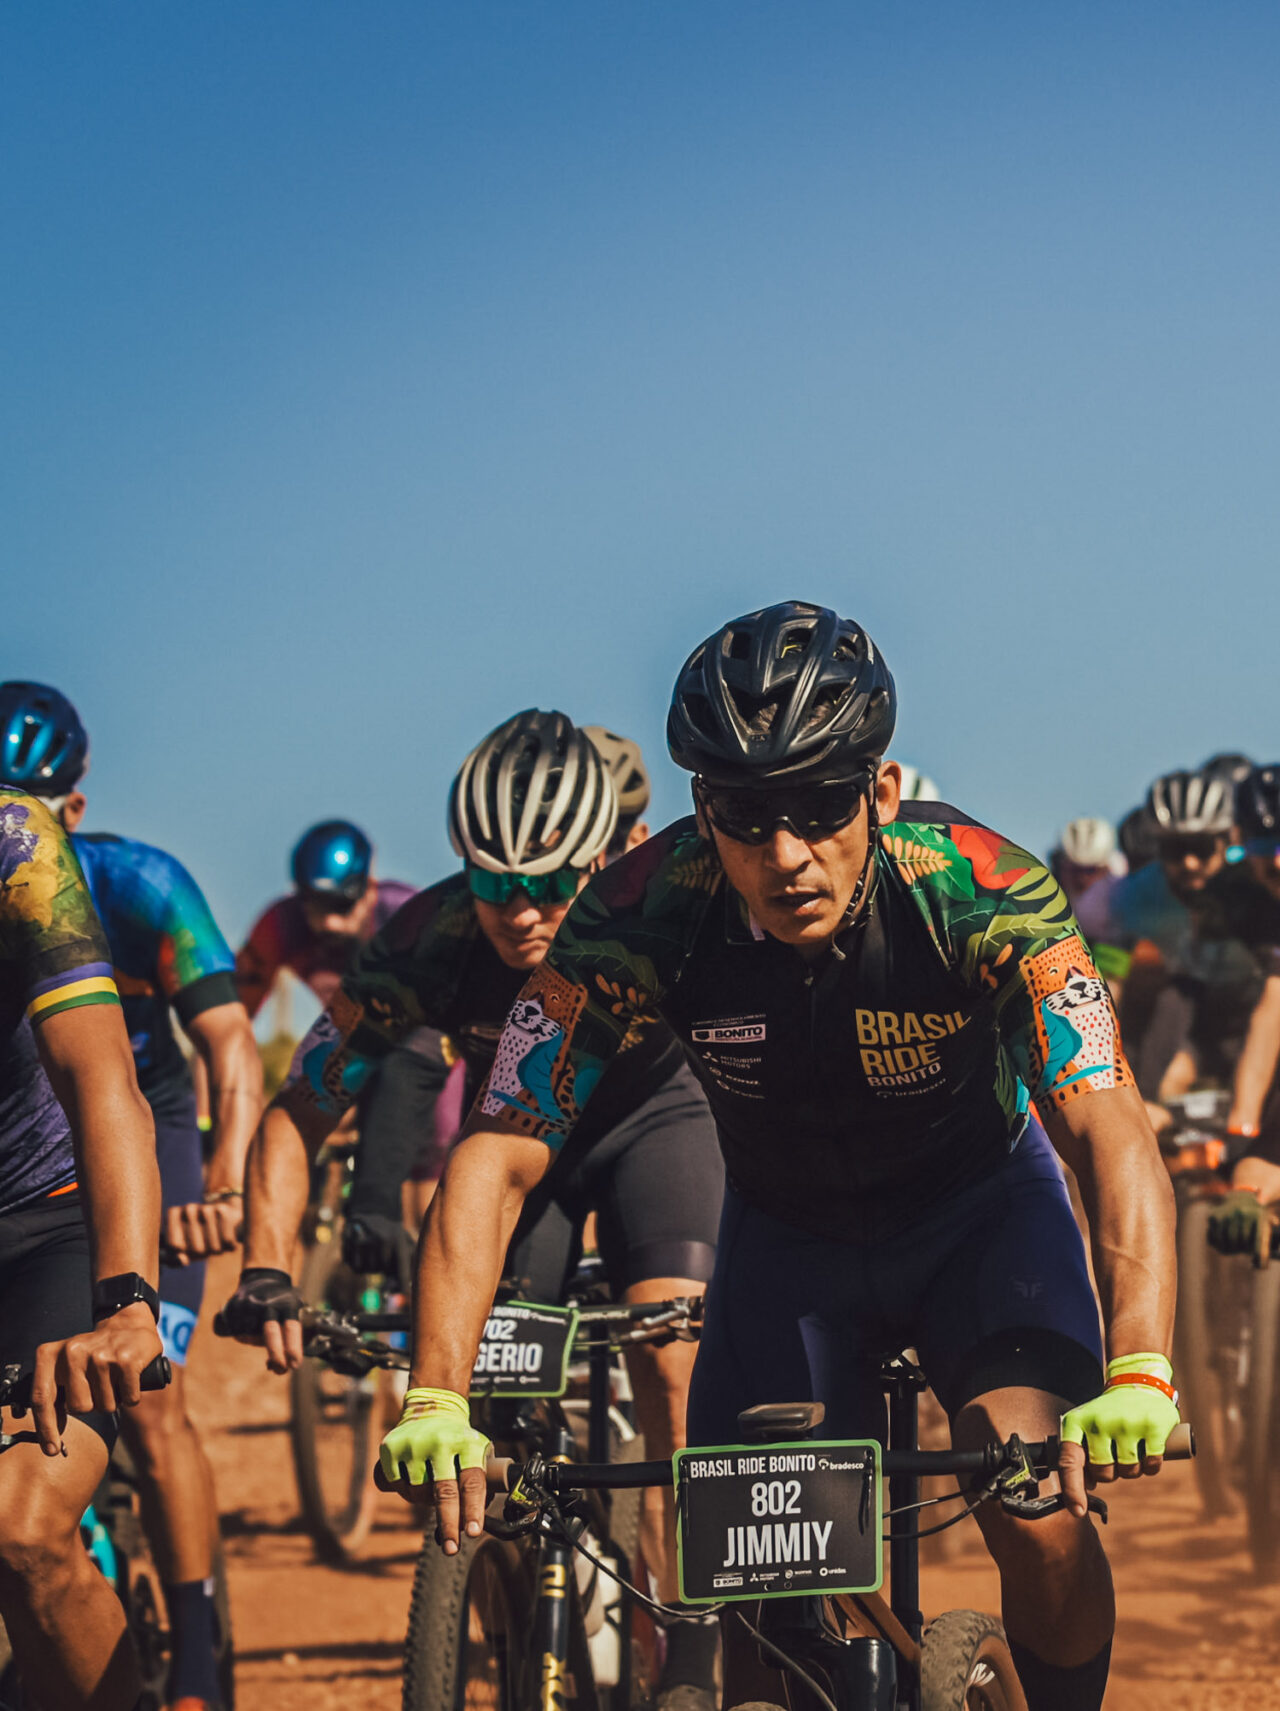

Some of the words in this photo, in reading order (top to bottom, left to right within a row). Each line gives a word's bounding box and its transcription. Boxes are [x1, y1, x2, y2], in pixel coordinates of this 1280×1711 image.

[714, 1026, 763, 1038] BONITO
[855, 1008, 972, 1045] BRASIL
[859, 1042, 941, 1076] RIDE
[867, 1062, 942, 1087] BONITO
[482, 1318, 517, 1340] 02
[690, 1459, 735, 1479] BRASIL
[738, 1457, 766, 1475] RIDE
[769, 1454, 816, 1473] BONITO
[829, 1461, 864, 1471] bradesco
[751, 1480, 801, 1517] 802
[723, 1520, 833, 1568] JIMMIY
